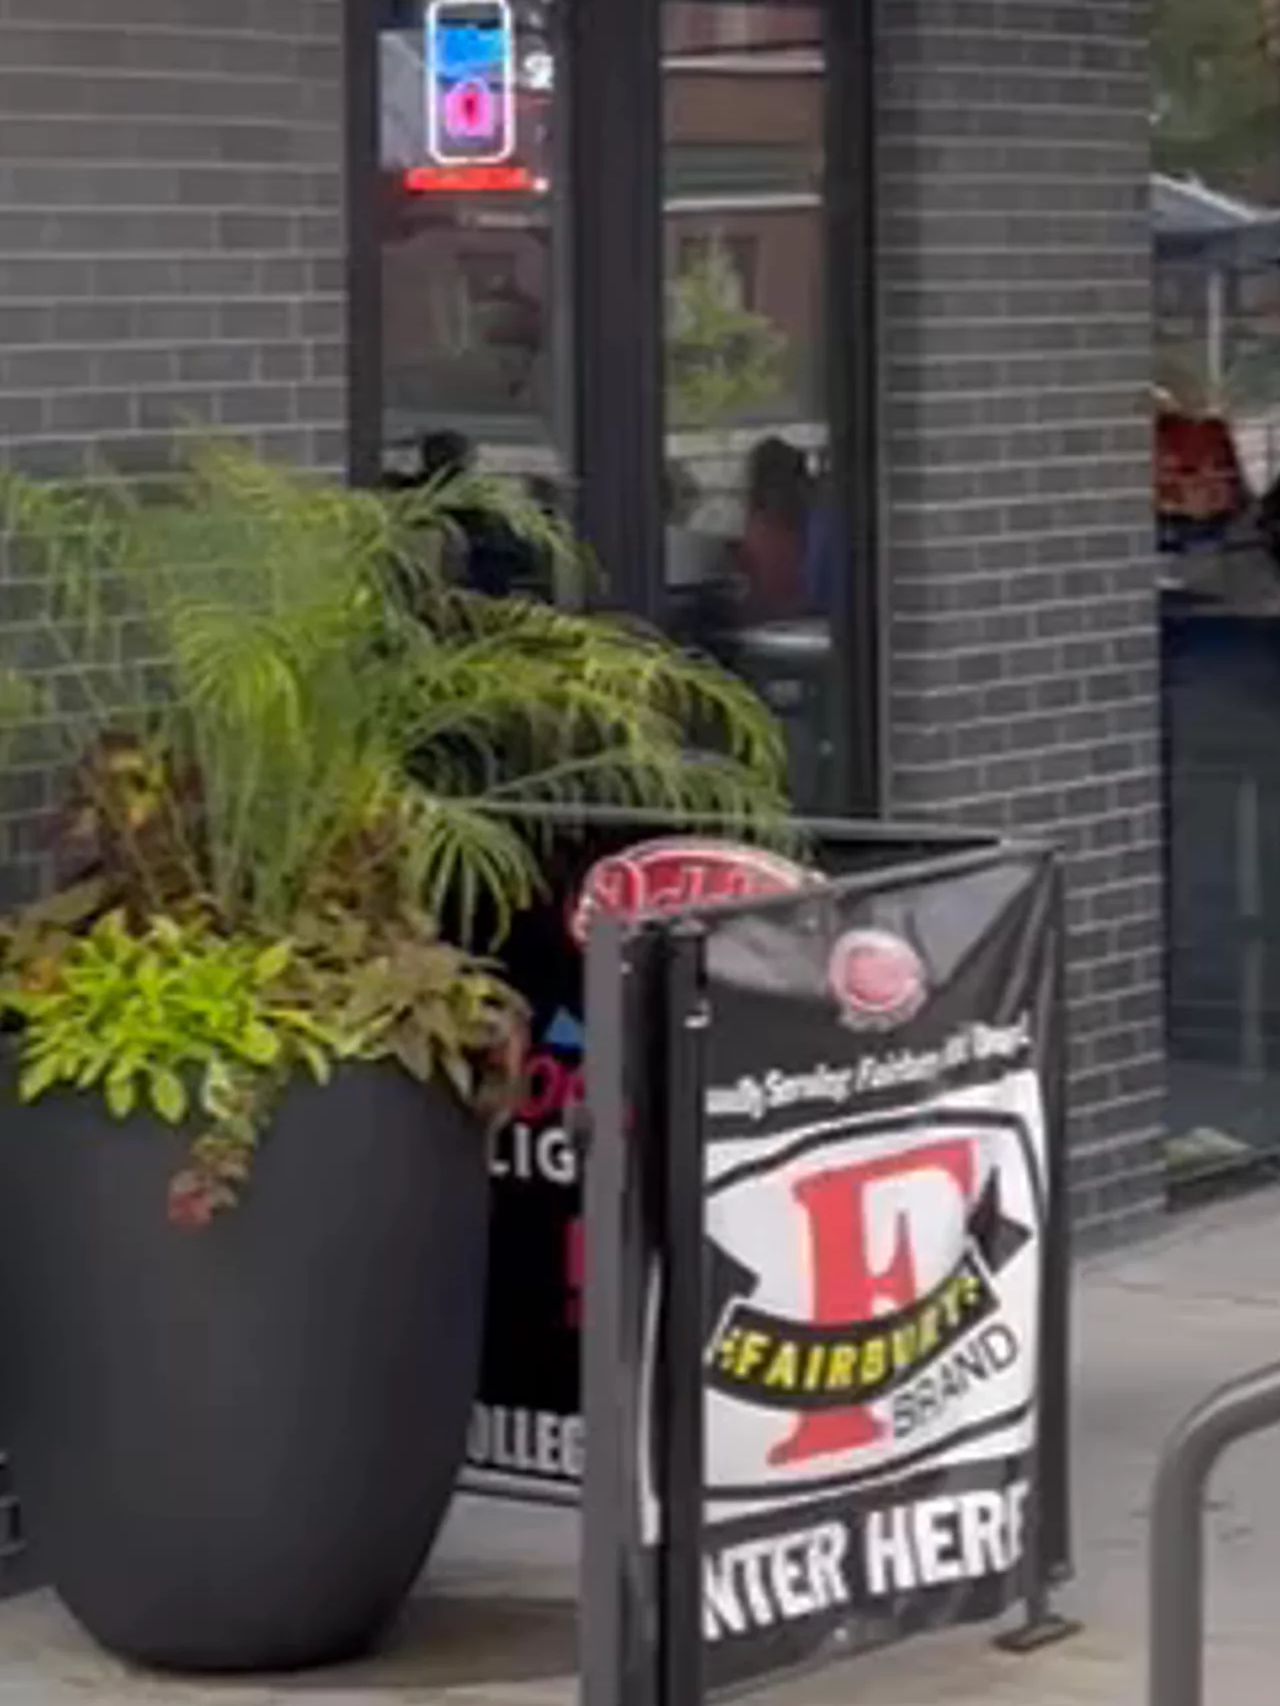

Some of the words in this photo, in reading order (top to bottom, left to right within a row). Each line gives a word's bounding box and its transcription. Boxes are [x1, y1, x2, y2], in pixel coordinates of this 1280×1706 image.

[487, 1122, 578, 1183] LIG
[734, 1278, 966, 1390] FAIRBURY
[893, 1323, 1019, 1437] BRAND
[704, 1520, 851, 1640] NTER
